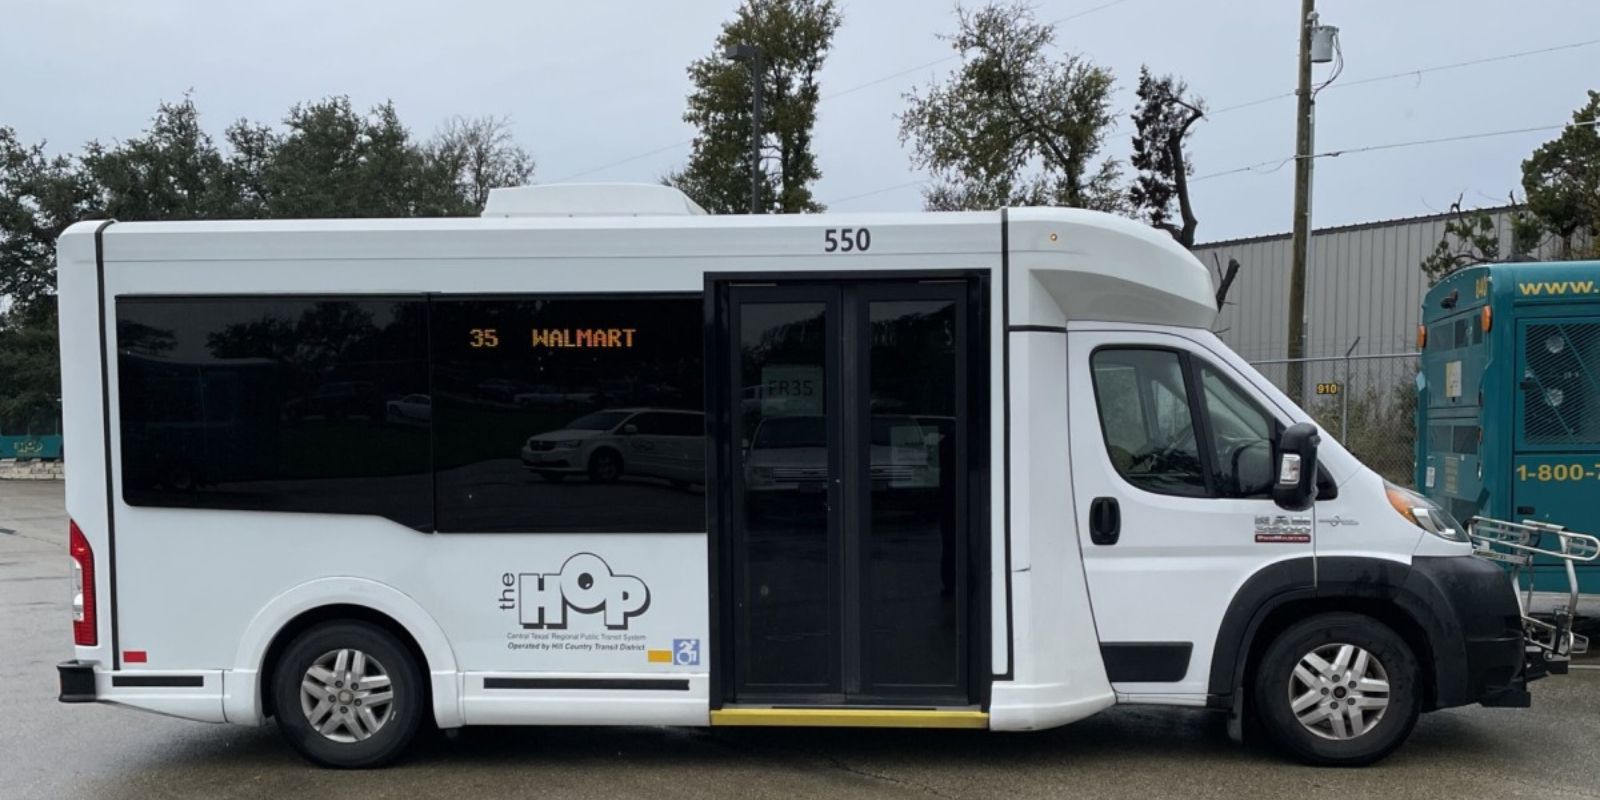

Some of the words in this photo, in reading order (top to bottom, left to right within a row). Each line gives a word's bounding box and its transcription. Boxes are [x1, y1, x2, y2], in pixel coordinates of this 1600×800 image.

[824, 227, 871, 253] 550
[1519, 281, 1600, 296] www.
[469, 328, 499, 347] 35
[531, 328, 636, 348] WALMART
[768, 379, 814, 397] FR35
[1318, 384, 1337, 394] 910
[498, 572, 516, 610] the
[506, 632, 530, 640] Central
[551, 632, 579, 642] Regional
[623, 634, 646, 643] System
[507, 642, 540, 650] Operated
[541, 643, 550, 651] by
[565, 643, 593, 651] Country
